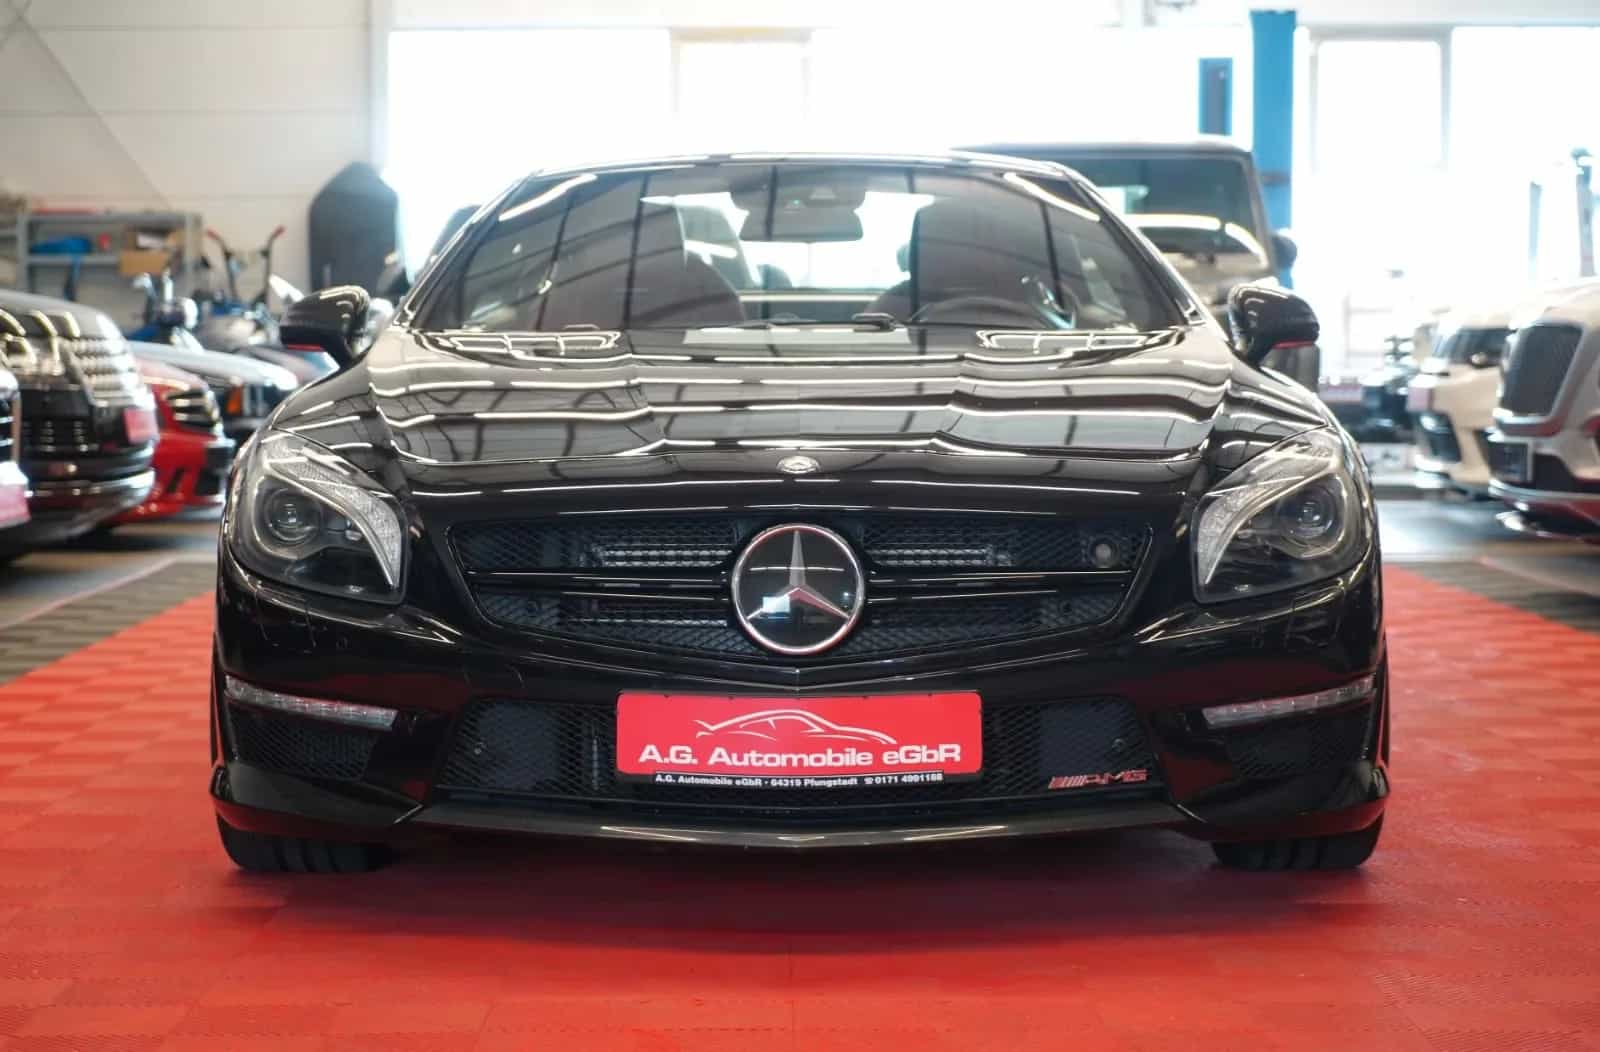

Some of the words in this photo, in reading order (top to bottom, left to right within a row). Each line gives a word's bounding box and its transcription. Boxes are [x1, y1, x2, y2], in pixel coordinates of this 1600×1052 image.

[638, 744, 698, 765] A.G.
[707, 747, 873, 768] Automobile
[882, 743, 961, 765] eGbR
[655, 774, 676, 783] A.G.
[678, 775, 733, 786] Automobile
[735, 778, 762, 787] eGbR
[803, 777, 858, 788] Pfungstadt
[874, 775, 898, 785] 0171
